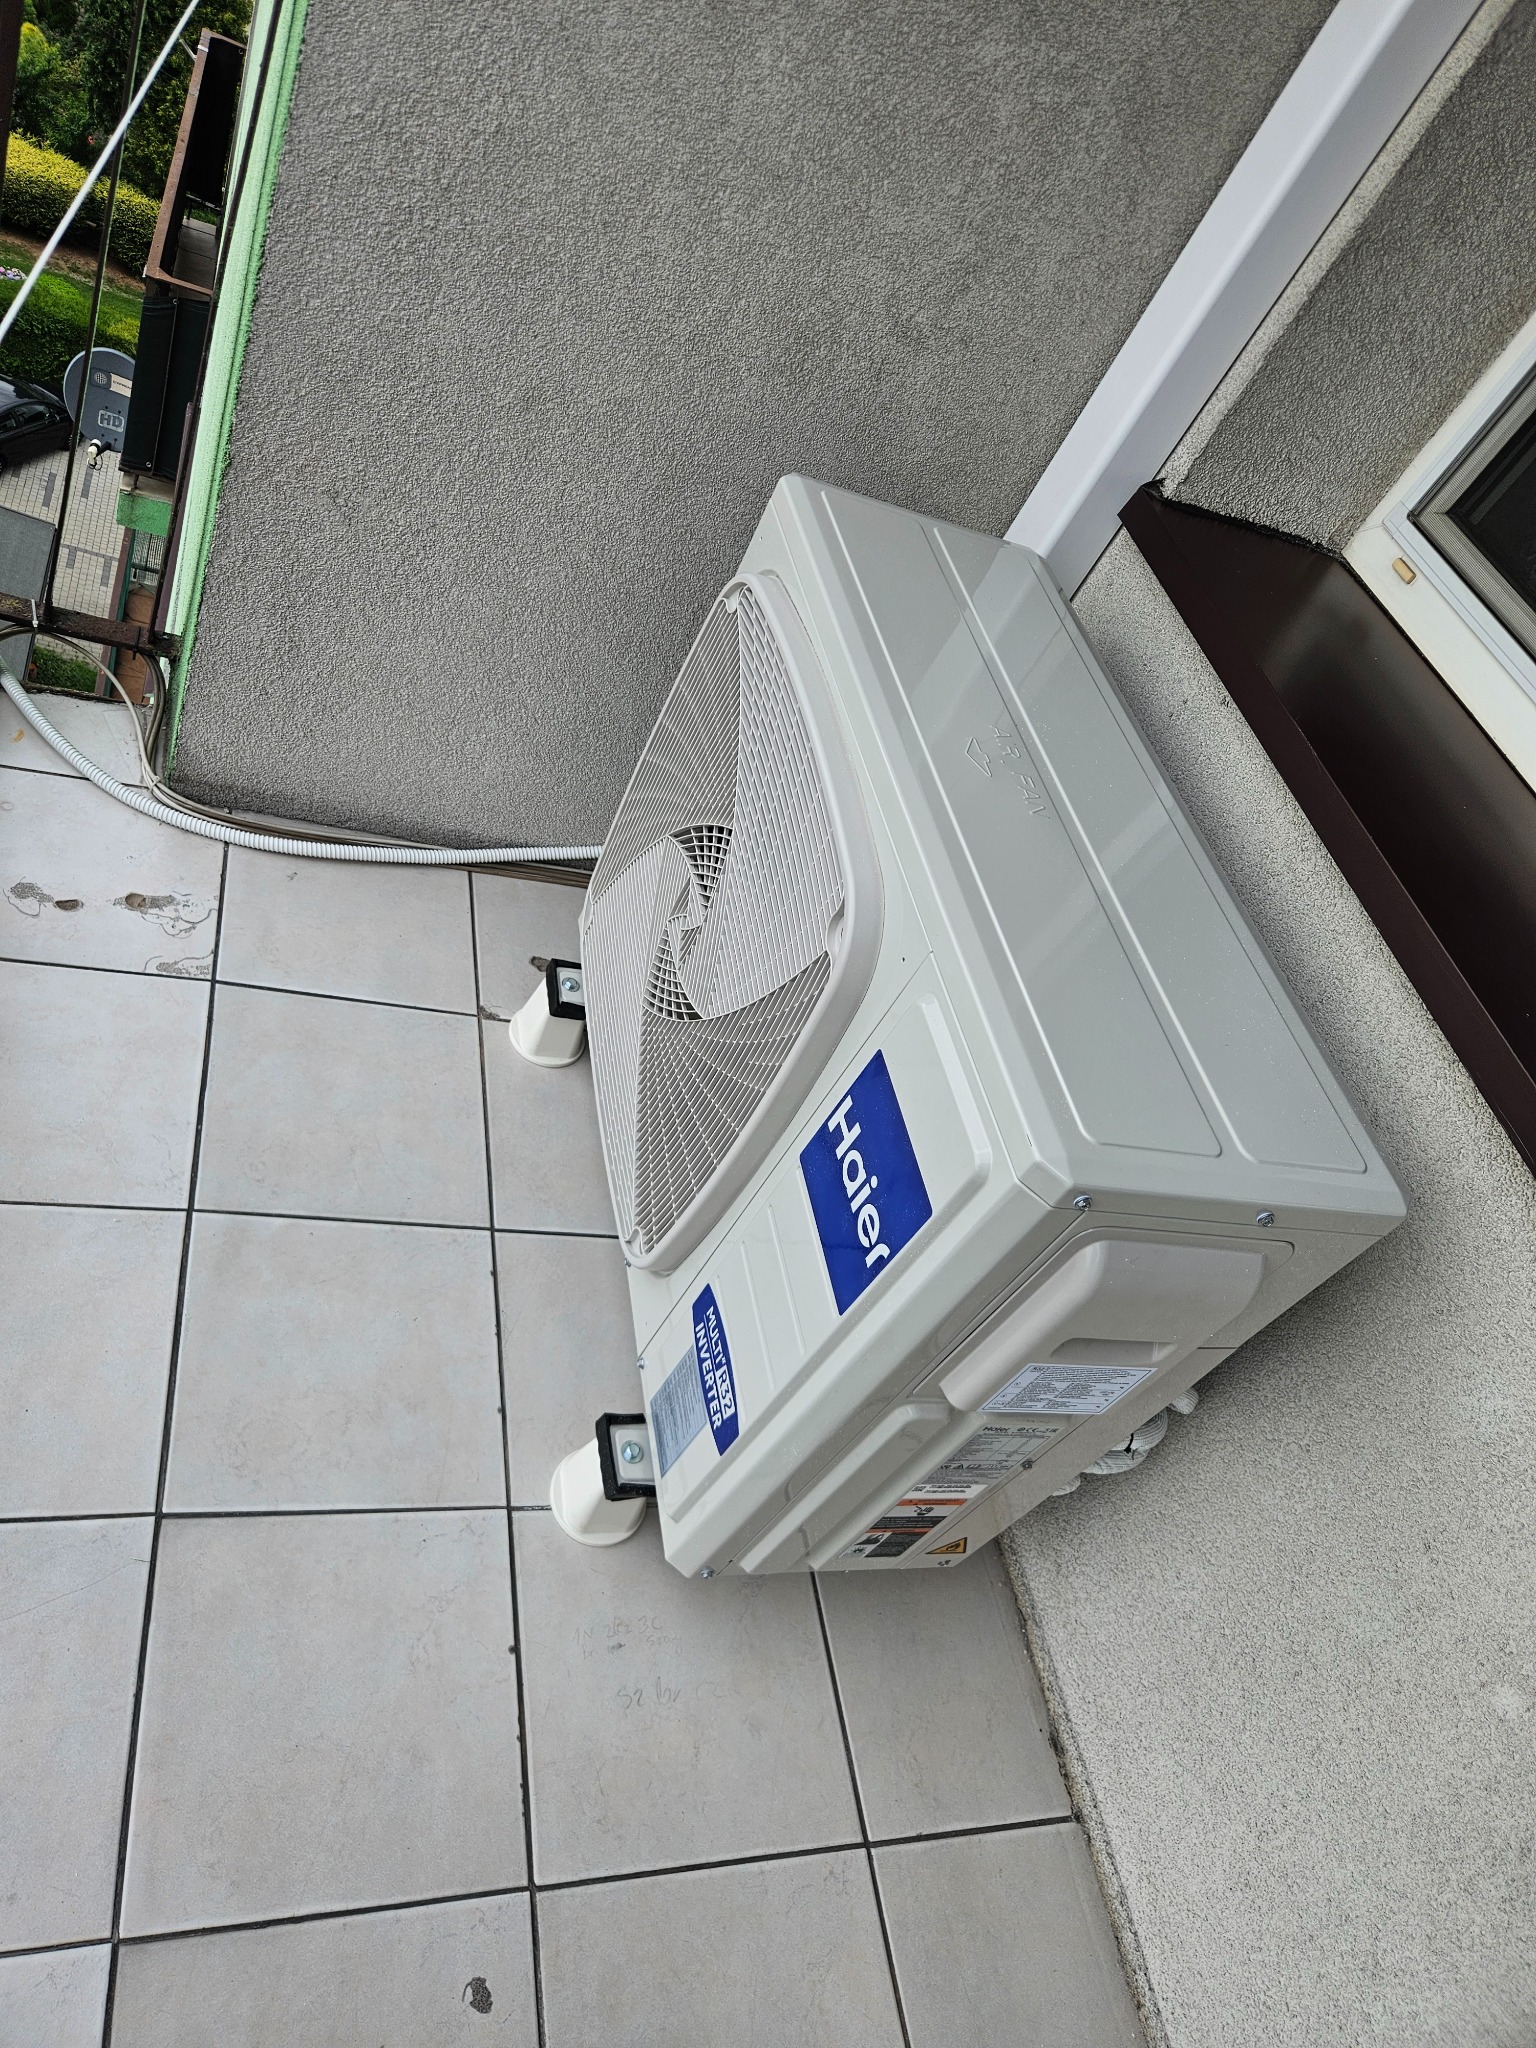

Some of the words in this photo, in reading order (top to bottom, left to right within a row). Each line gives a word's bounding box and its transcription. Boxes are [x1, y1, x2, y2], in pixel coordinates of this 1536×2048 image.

[827, 1094, 891, 1269] Haier
[695, 1322, 722, 1430] INVERTER
[717, 1370, 733, 1415] R32
